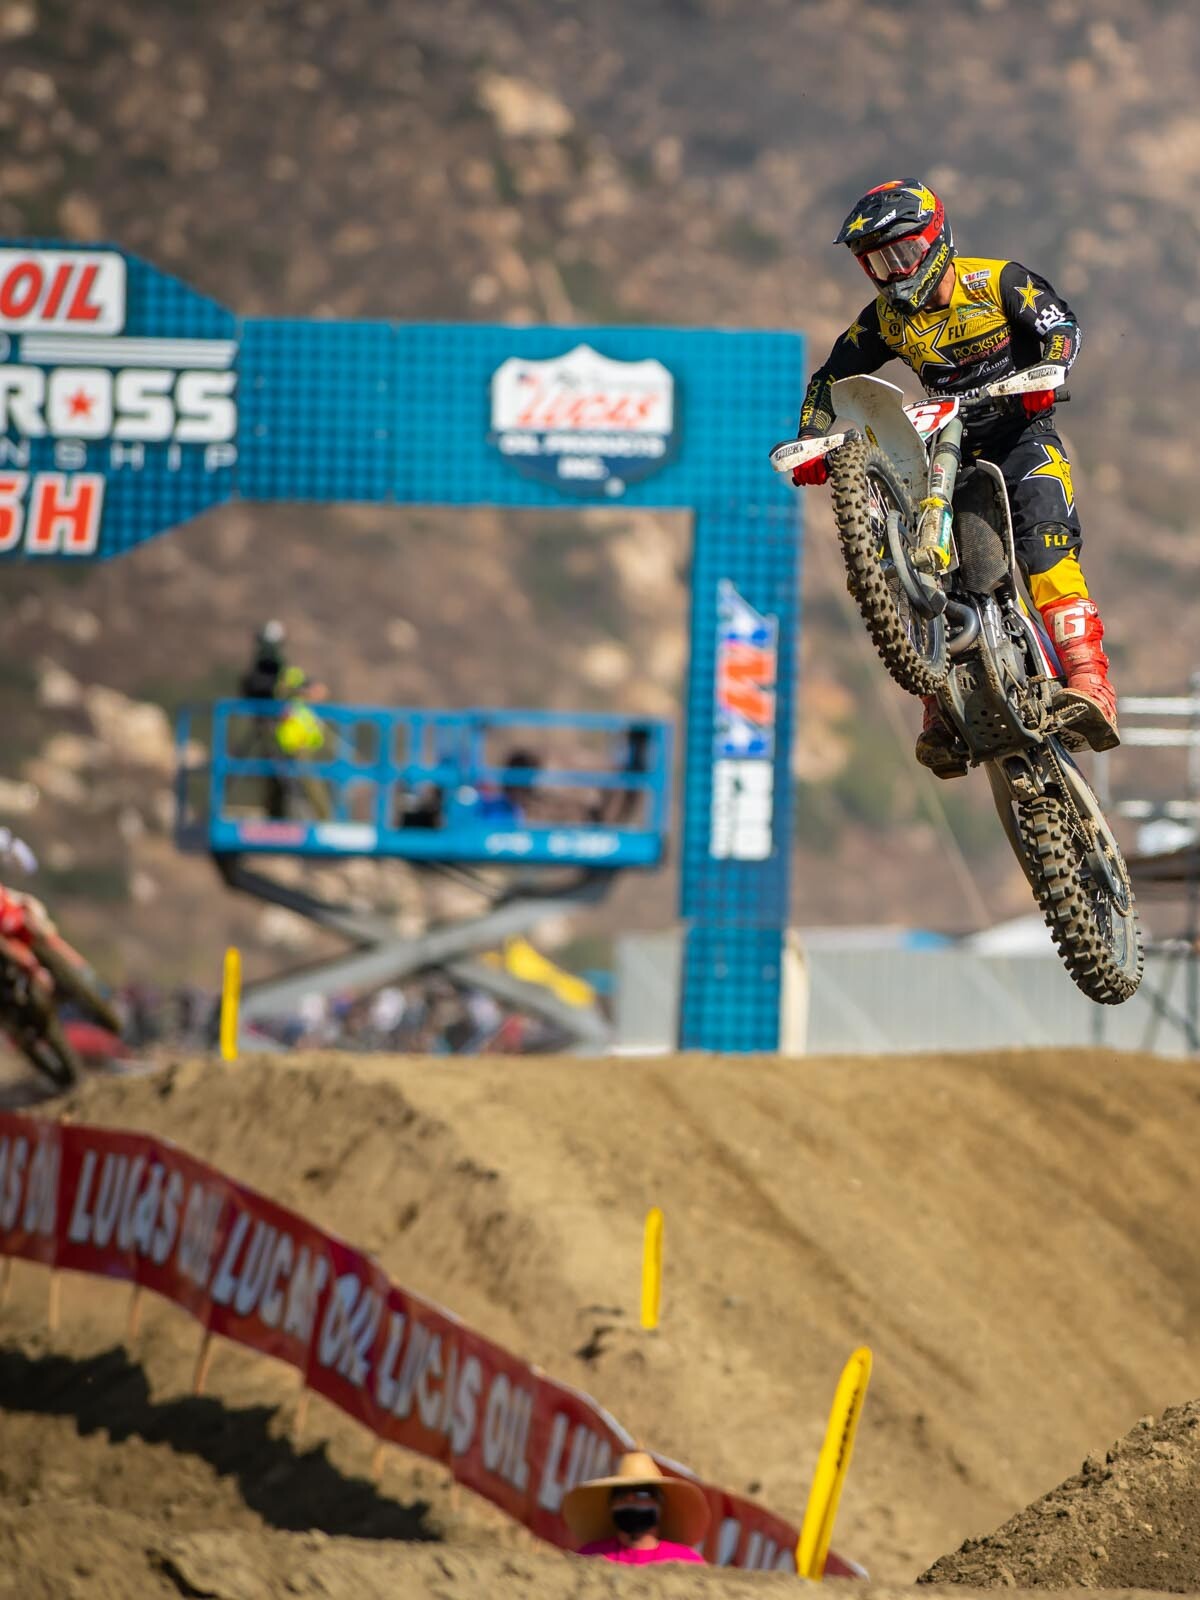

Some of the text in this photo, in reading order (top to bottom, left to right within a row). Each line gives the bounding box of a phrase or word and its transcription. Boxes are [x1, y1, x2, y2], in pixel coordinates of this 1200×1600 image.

[0, 261, 103, 321] OIL
[948, 323, 967, 340] FLY
[1044, 534, 1069, 548] FLY
